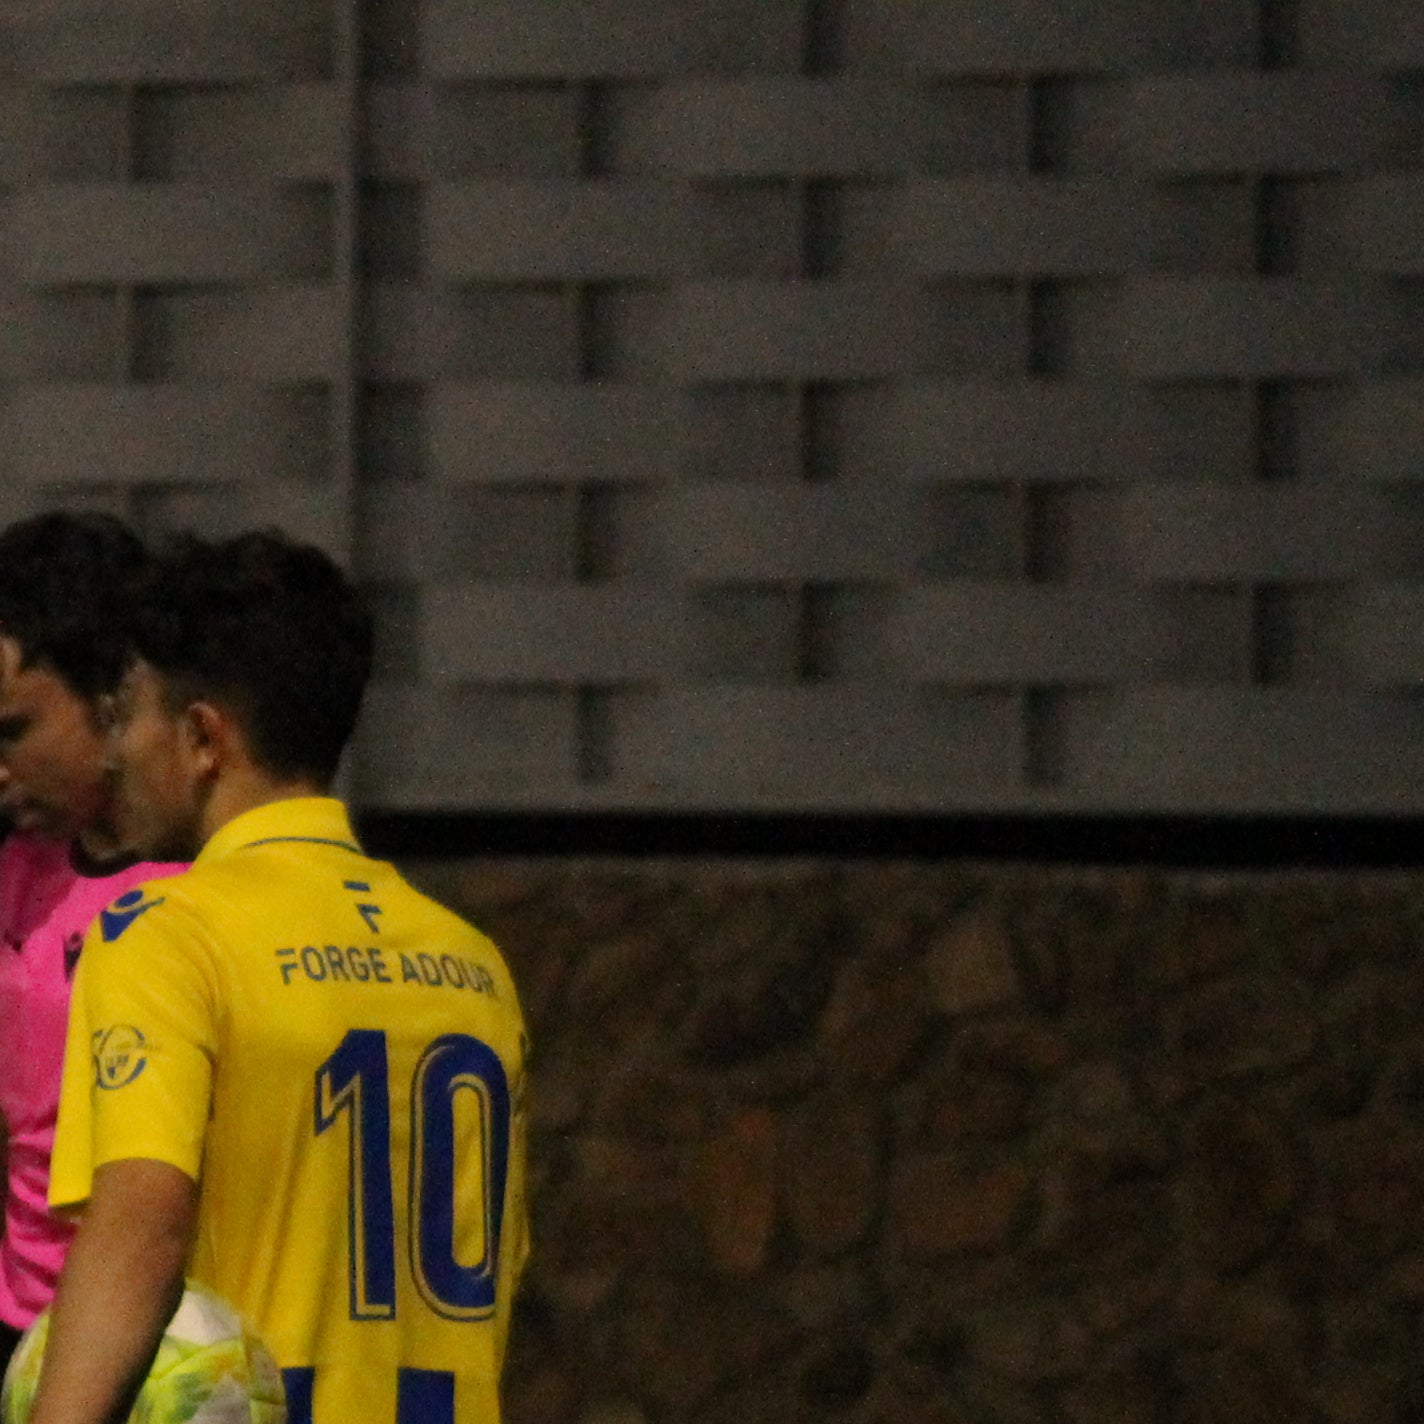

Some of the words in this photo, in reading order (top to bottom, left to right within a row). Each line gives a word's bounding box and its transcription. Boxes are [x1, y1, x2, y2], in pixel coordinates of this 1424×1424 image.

[275, 944, 392, 986] FORGE
[399, 950, 497, 997] ADOUR
[313, 1028, 511, 1323] 10
